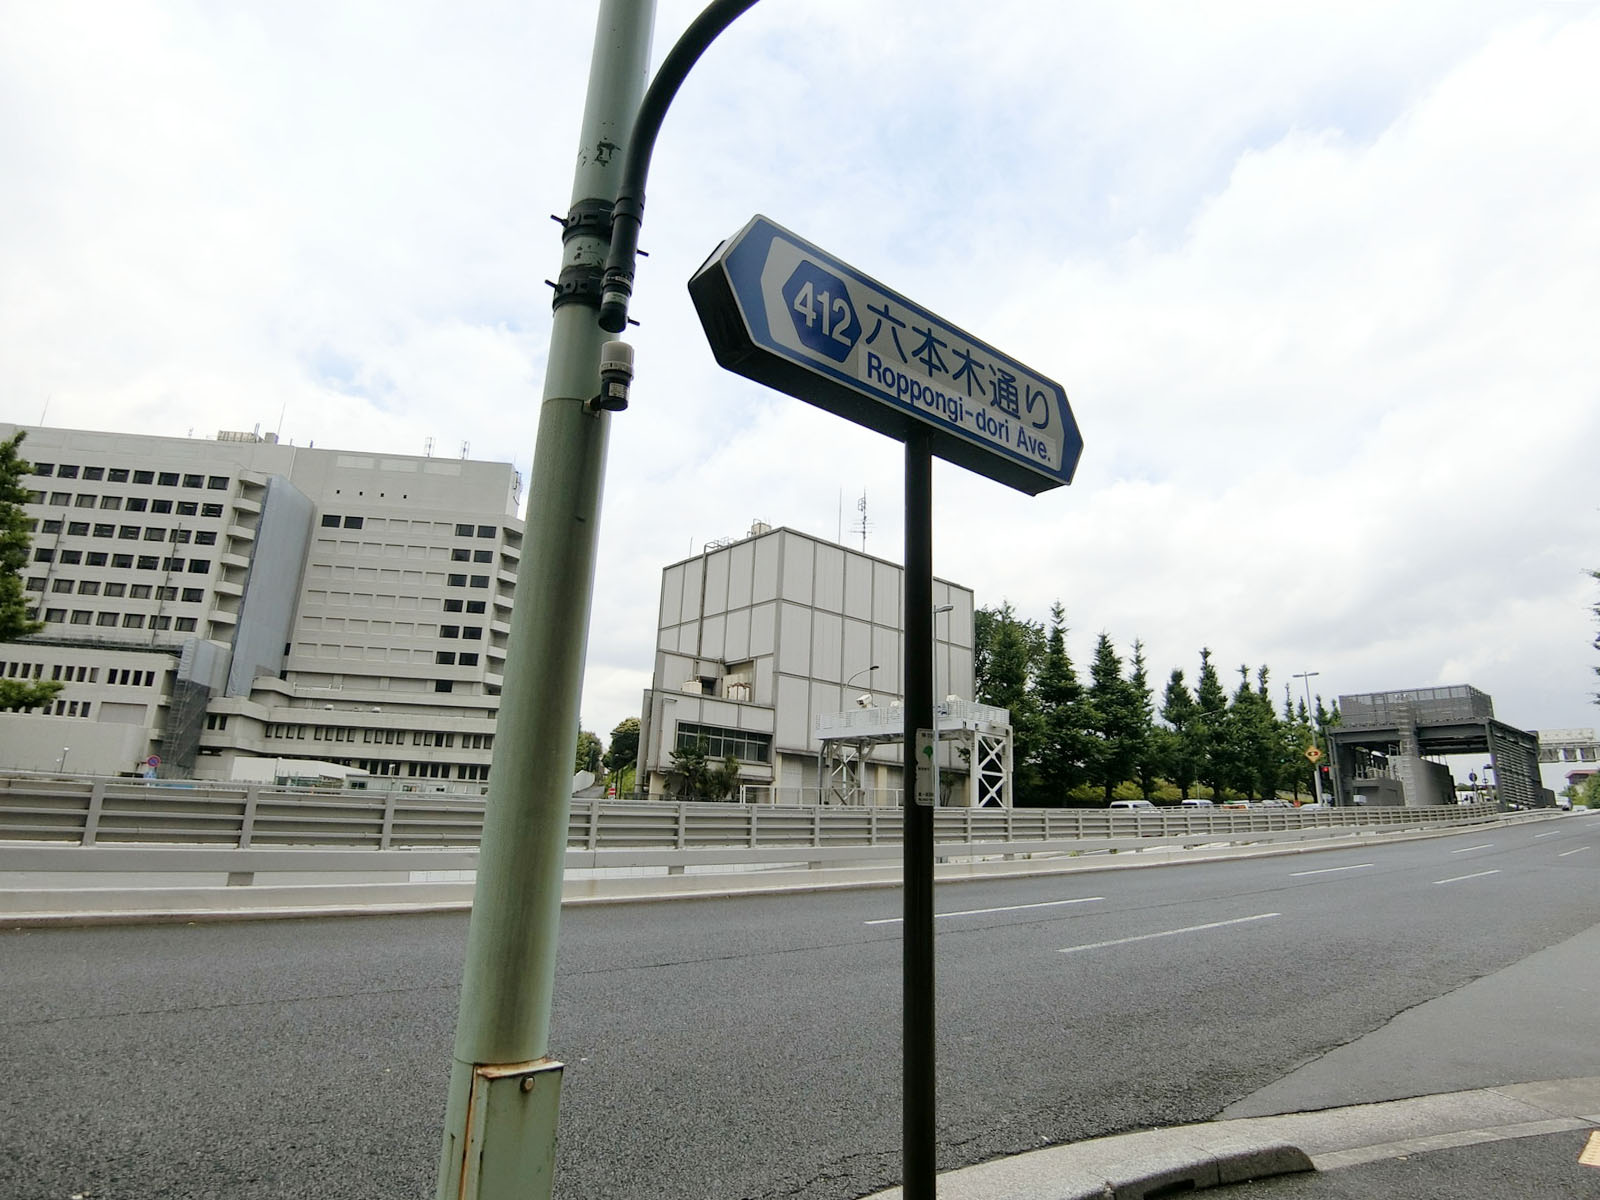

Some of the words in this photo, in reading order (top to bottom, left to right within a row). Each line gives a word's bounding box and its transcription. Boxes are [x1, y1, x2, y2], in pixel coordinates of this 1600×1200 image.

[794, 281, 852, 347] 412
[866, 303, 1050, 429] 六本木通り
[867, 353, 1009, 443] Roppongi-dori
[1017, 428, 1052, 462] Ave.
